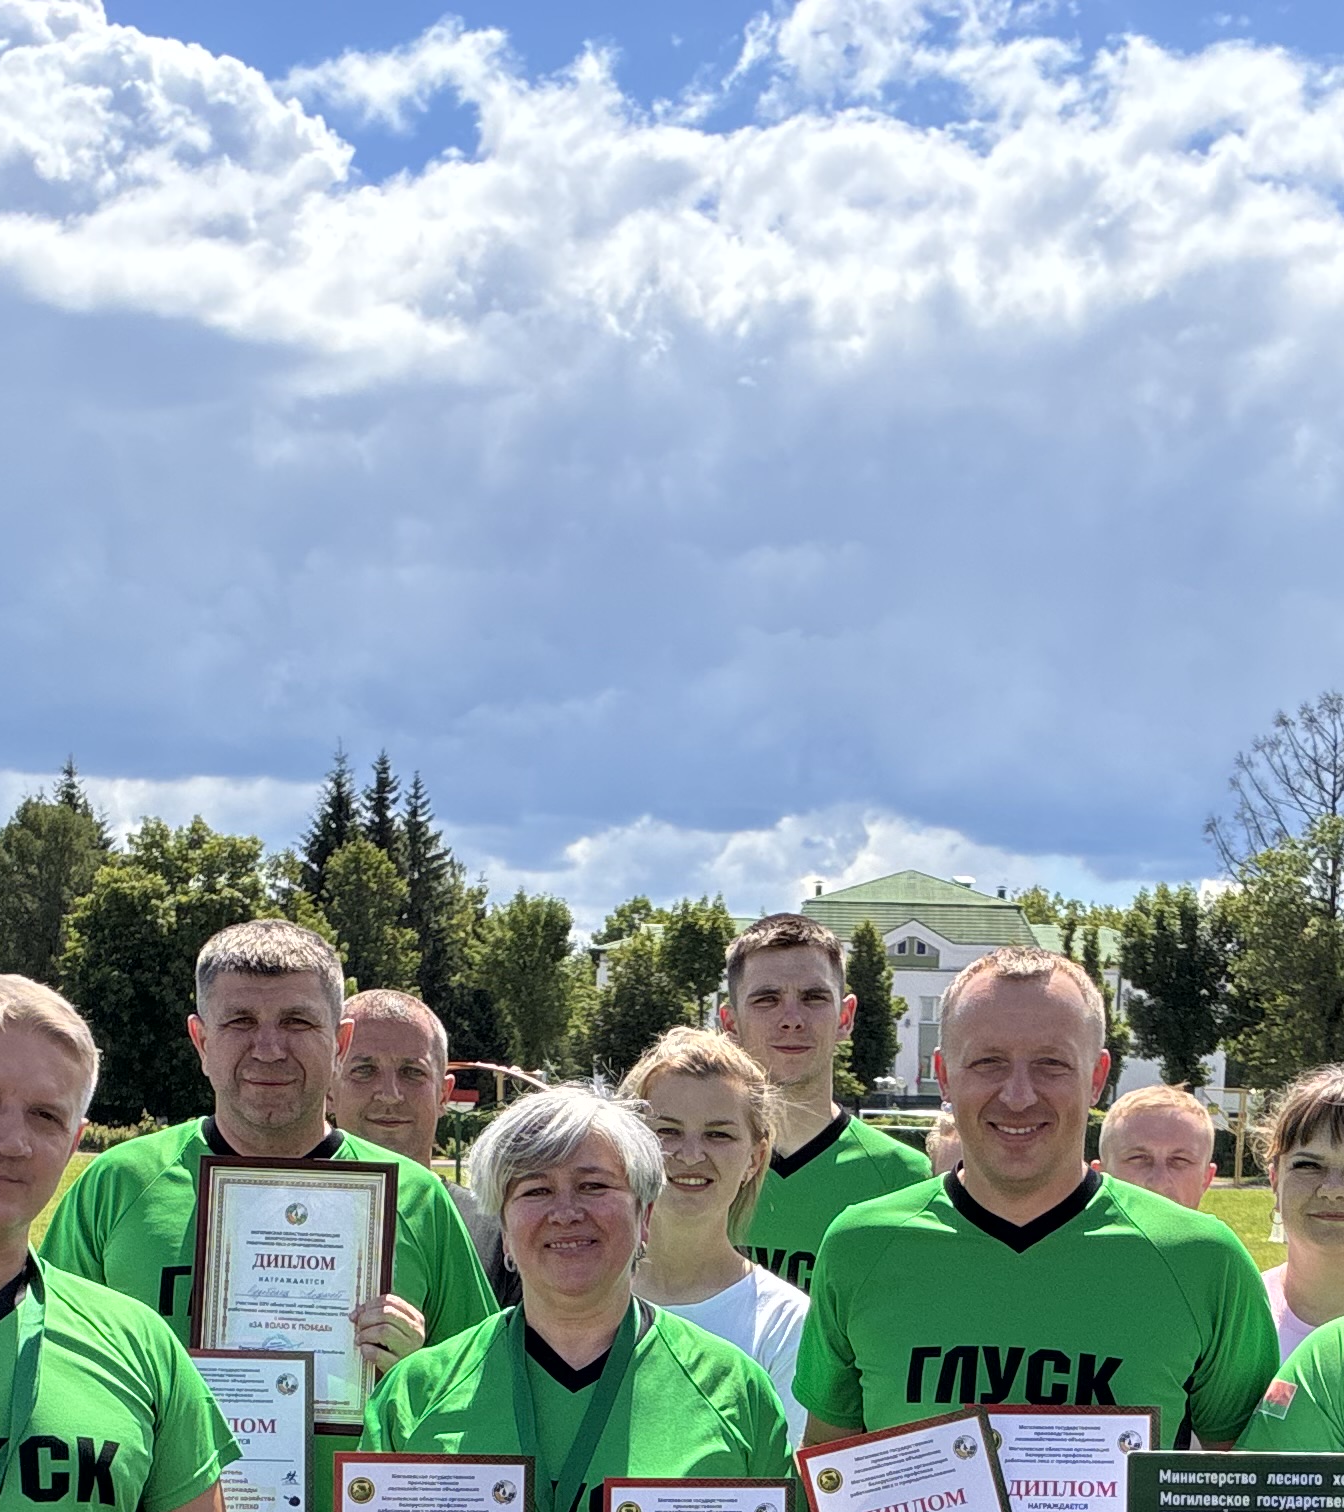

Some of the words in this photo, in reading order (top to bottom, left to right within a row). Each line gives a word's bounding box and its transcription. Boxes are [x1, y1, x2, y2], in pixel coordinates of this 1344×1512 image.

[252, 1253, 335, 1270] ДИПЛОМ
[258, 1277, 325, 1285] НАГРАЖДАЕТСЯ
[906, 1346, 1124, 1407] ГЛУСК
[227, 1417, 277, 1433] ЛОМ
[1159, 1470, 1257, 1487] Министерство
[1266, 1473, 1323, 1485] лесного
[1008, 1480, 1118, 1501] ДИПЛОМ
[1028, 1503, 1088, 1511] НАГРАЖДАЕТСЯ
[1159, 1491, 1250, 1507] Могилевское
